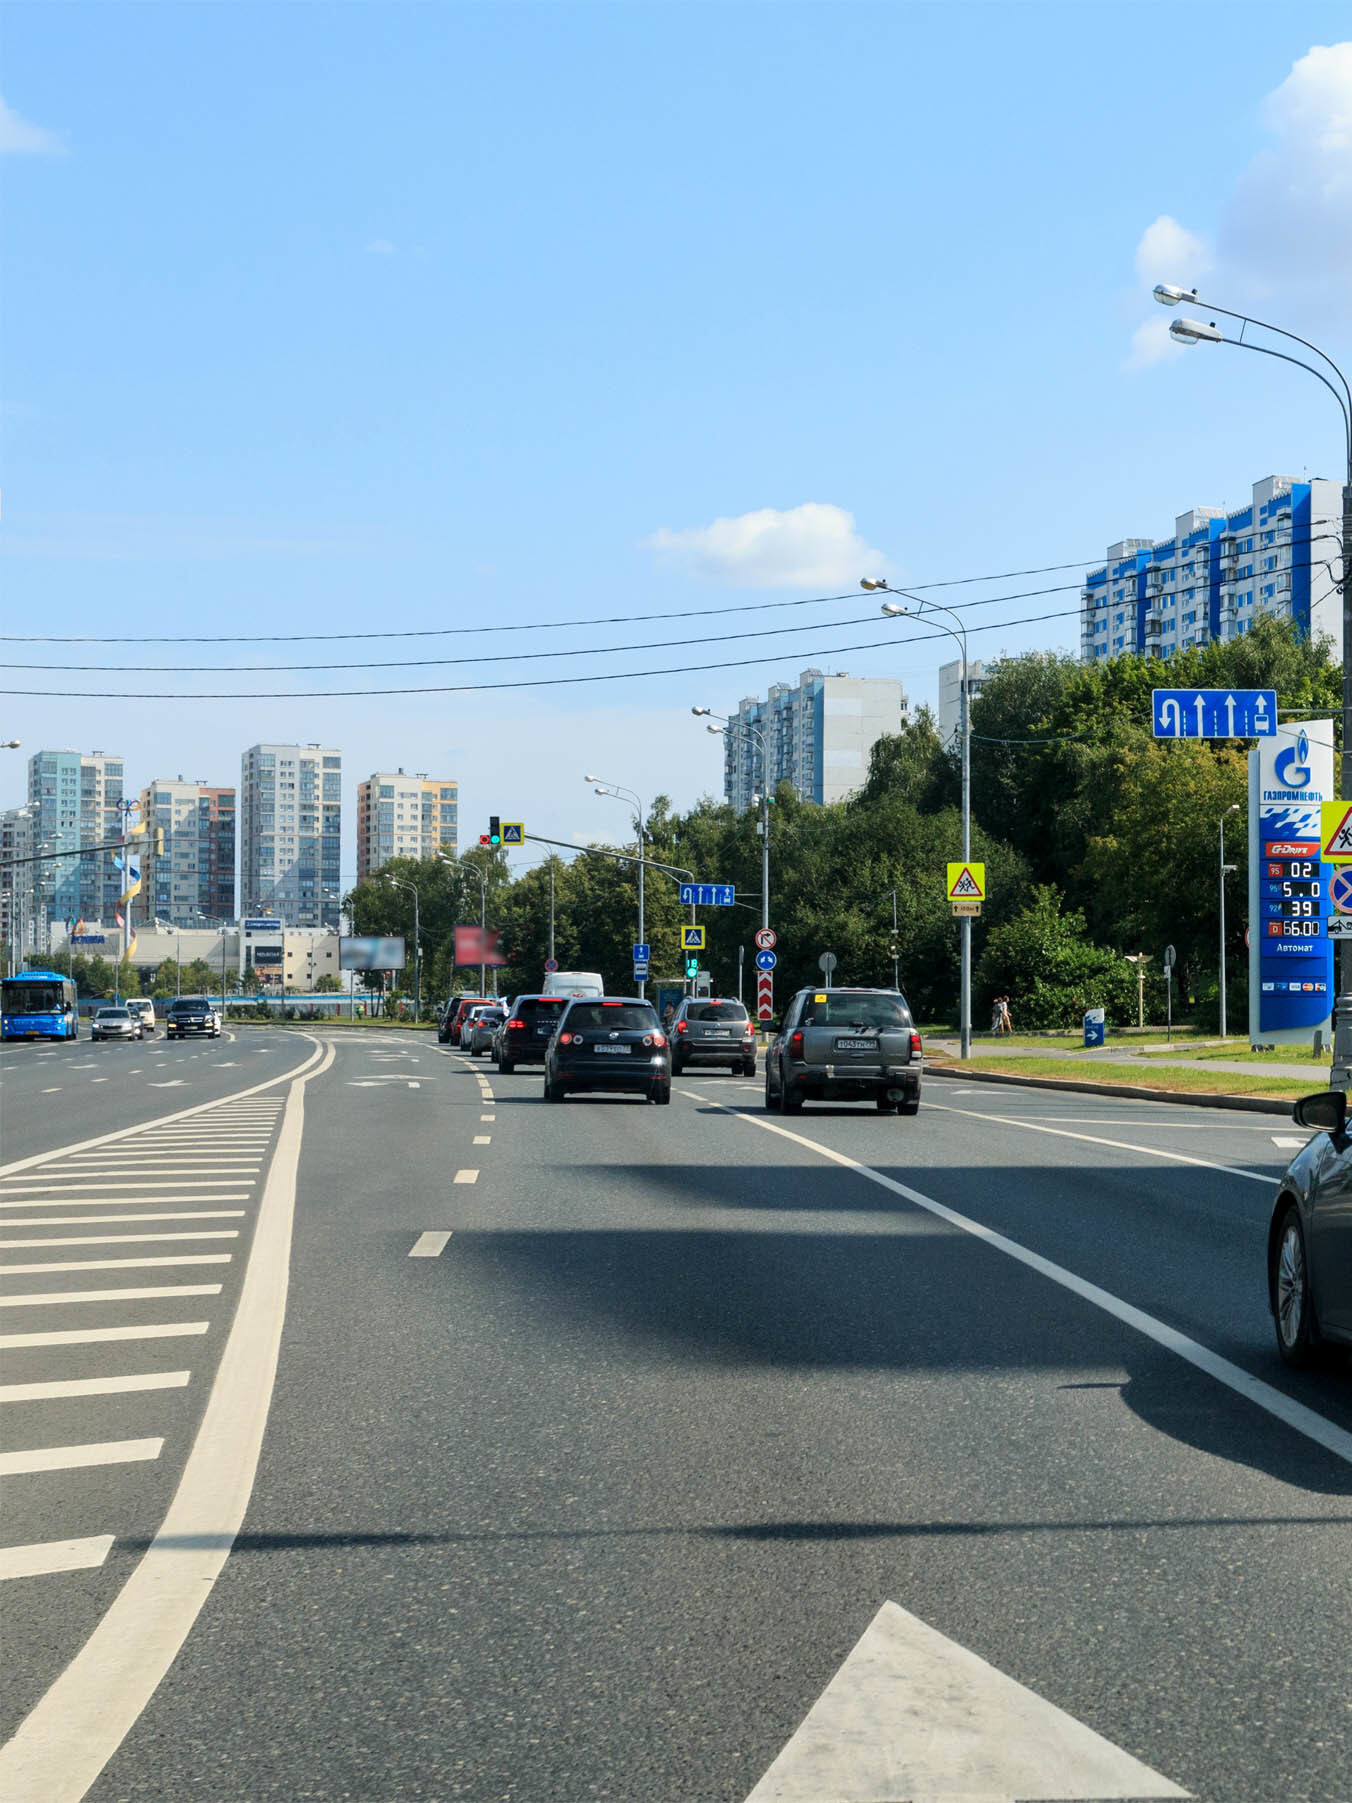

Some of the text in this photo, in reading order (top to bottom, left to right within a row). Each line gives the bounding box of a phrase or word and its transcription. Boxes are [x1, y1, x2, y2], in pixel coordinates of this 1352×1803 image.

[1263, 790, 1323, 801] ГАЗПРОМНЕФТЬ
[1291, 862, 1312, 878] 02
[1292, 901, 1312, 916] 39
[1276, 943, 1314, 952] Автомат
